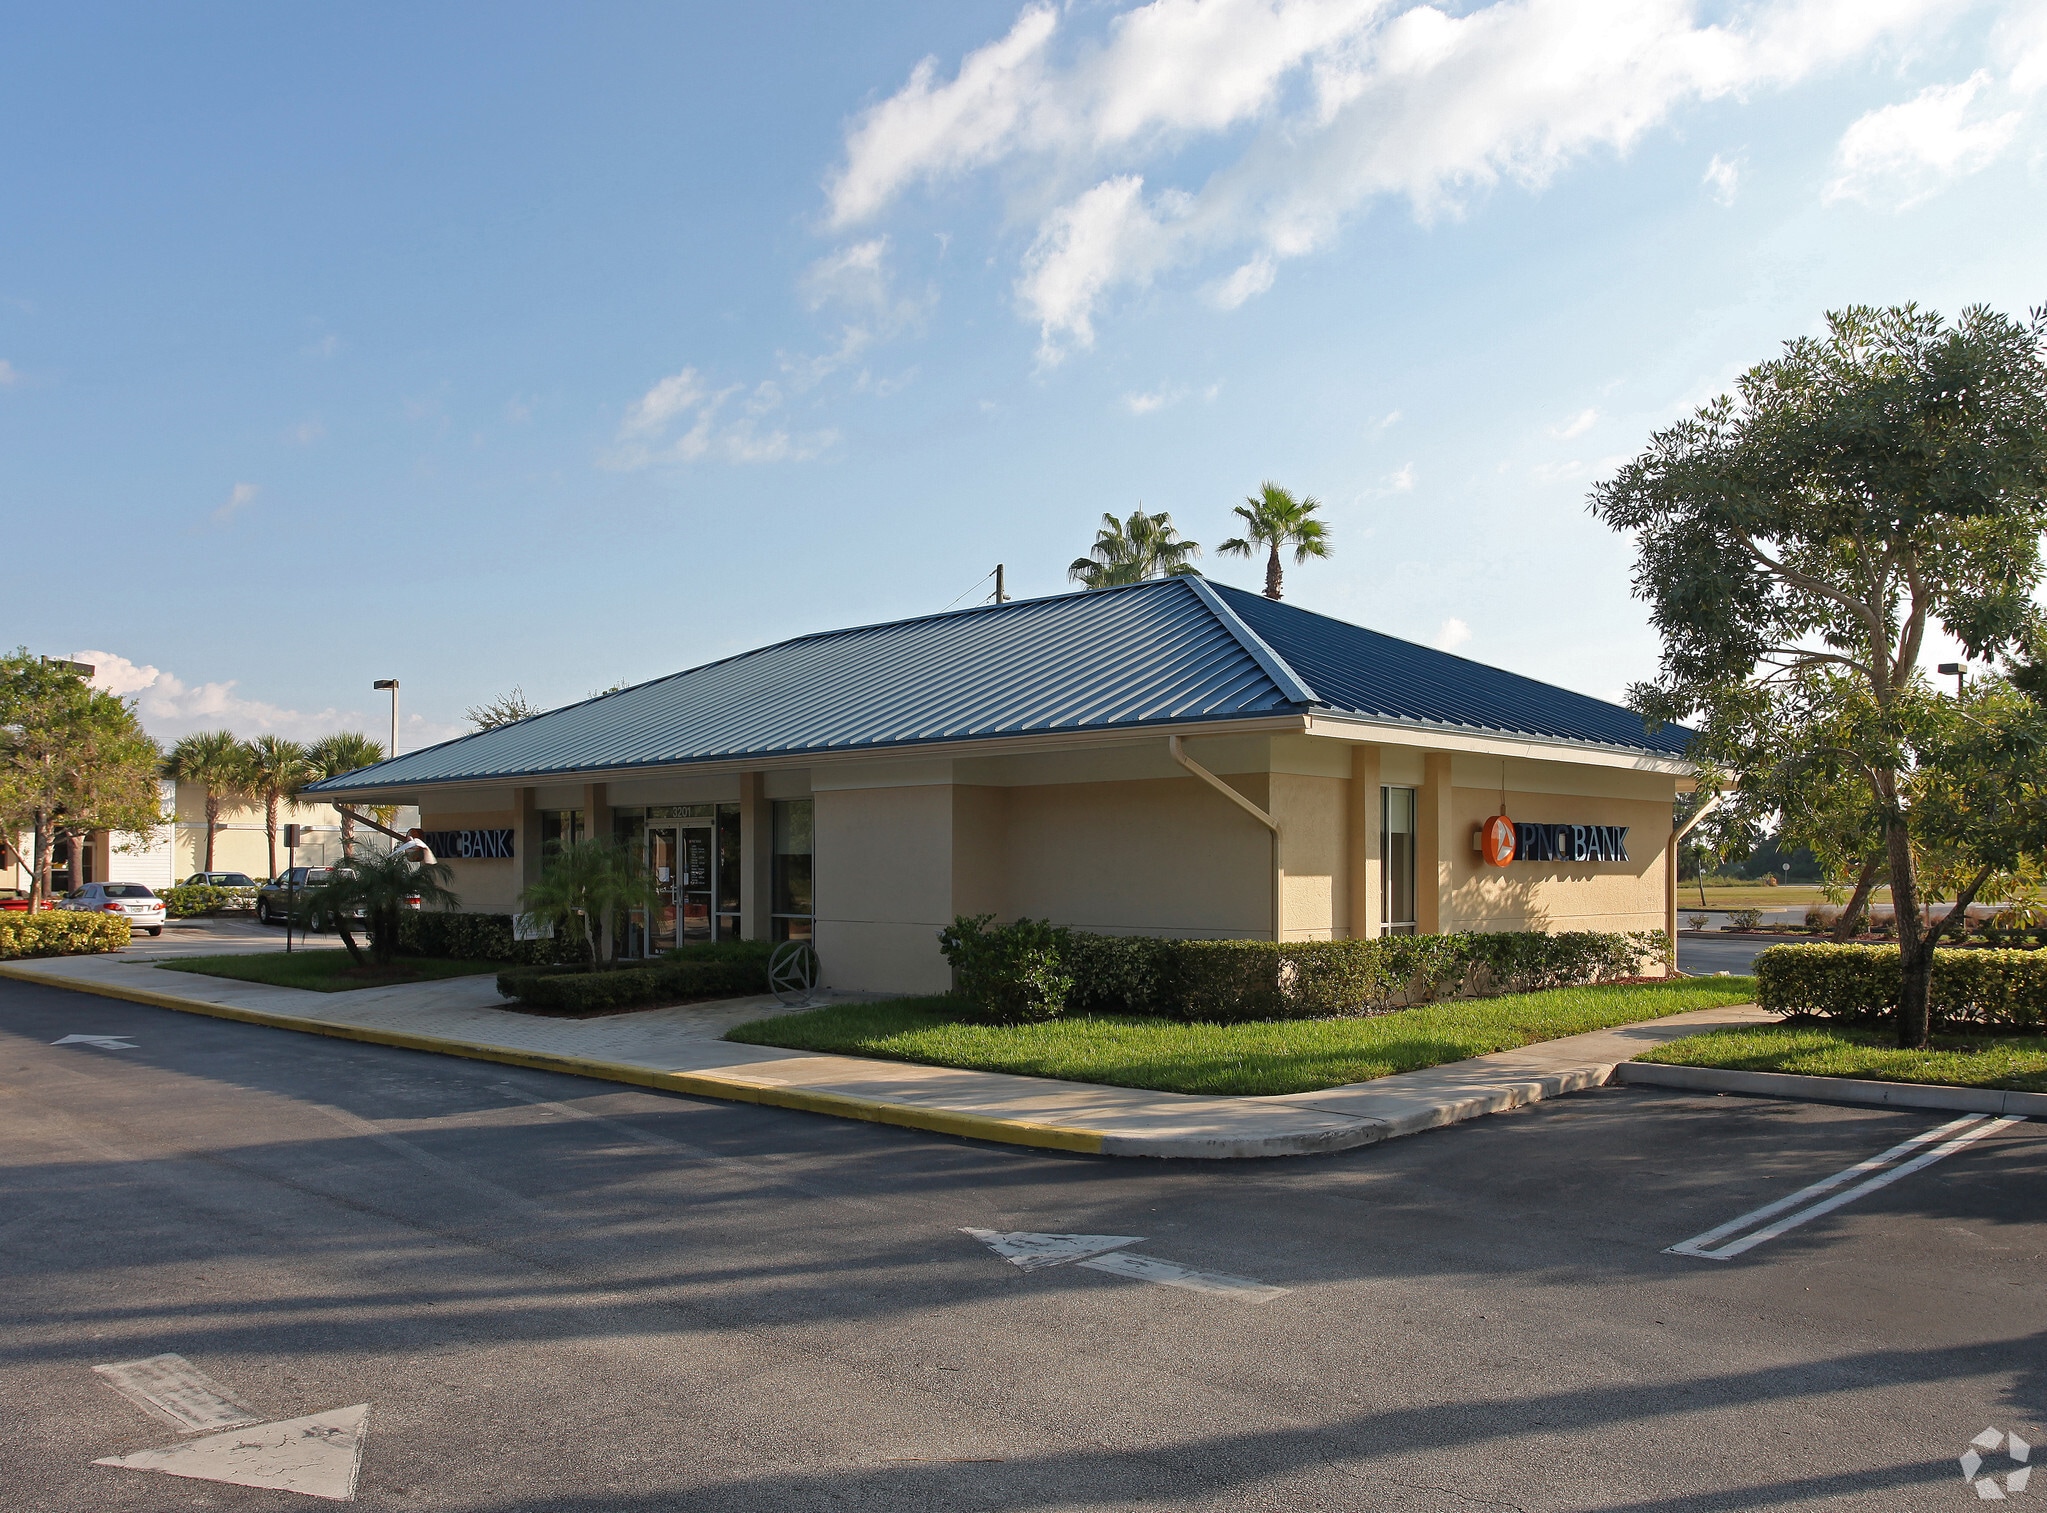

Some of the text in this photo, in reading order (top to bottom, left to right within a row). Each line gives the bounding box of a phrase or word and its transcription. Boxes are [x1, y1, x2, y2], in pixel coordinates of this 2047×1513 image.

[673, 806, 691, 818] 3201
[460, 829, 510, 858] BANK
[1519, 823, 1630, 862] PNC BANK
